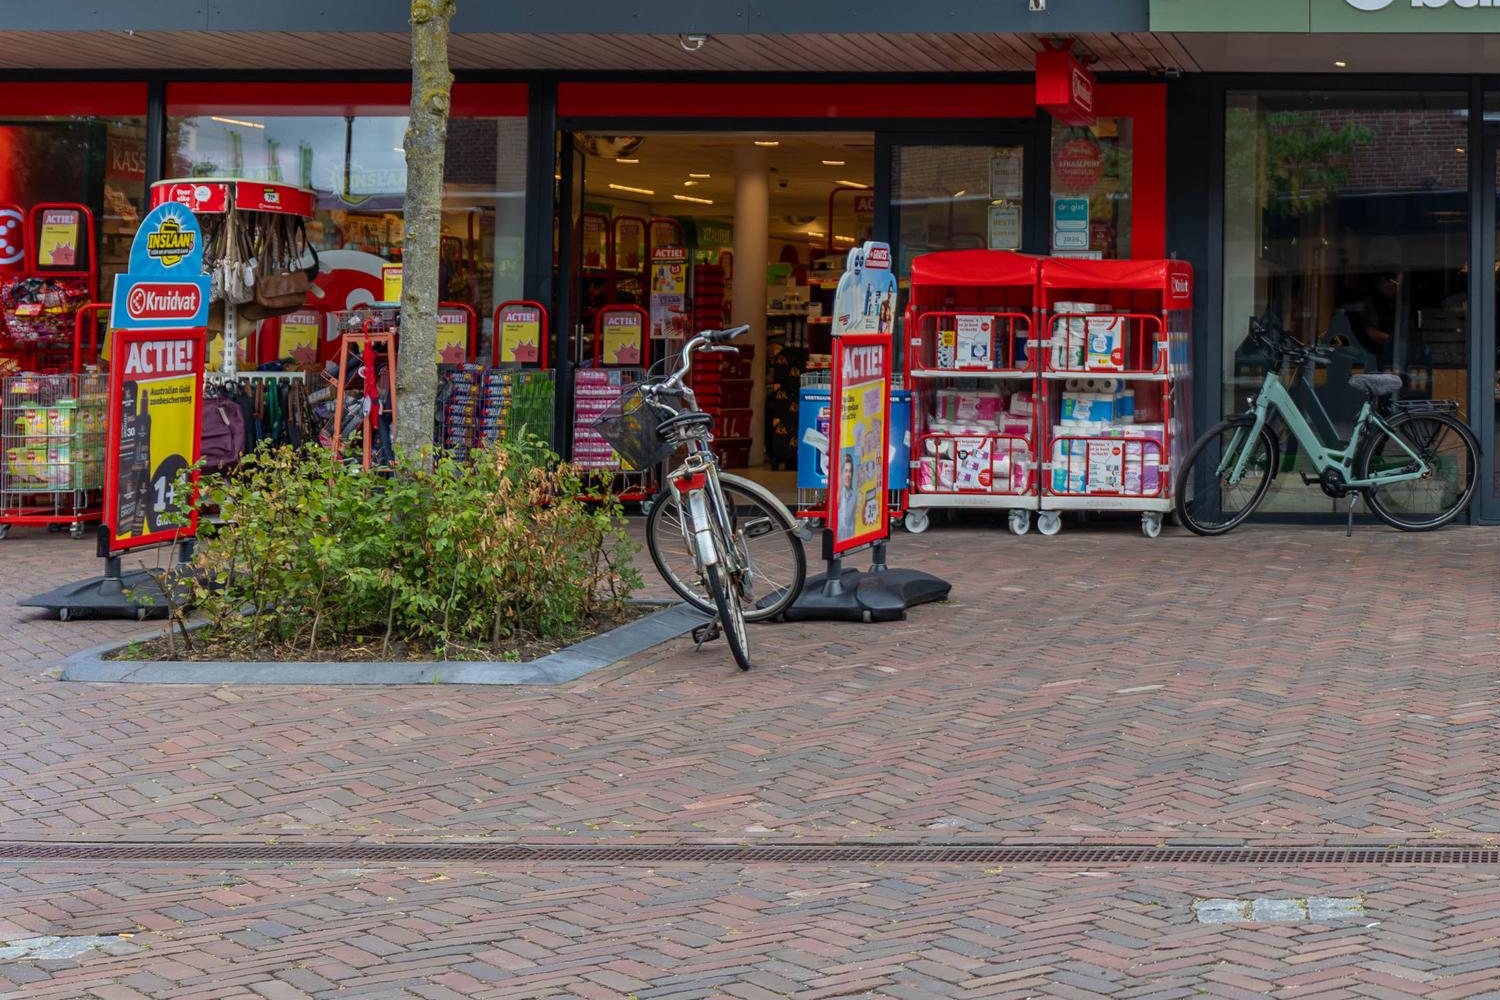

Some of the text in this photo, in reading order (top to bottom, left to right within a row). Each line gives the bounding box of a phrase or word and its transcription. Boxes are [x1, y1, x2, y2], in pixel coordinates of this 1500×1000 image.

[45, 214, 75, 224] ACTIE!
[148, 232, 195, 250] INSLAAN!
[654, 248, 684, 258] ACTIE!
[146, 290, 196, 311] Kruidvat
[285, 314, 315, 324] ACTIE!
[505, 312, 535, 322] ACTIE!
[607, 316, 637, 326] ACTIE!
[125, 339, 193, 374] ACTIE!
[843, 345, 883, 379] ACTIE!
